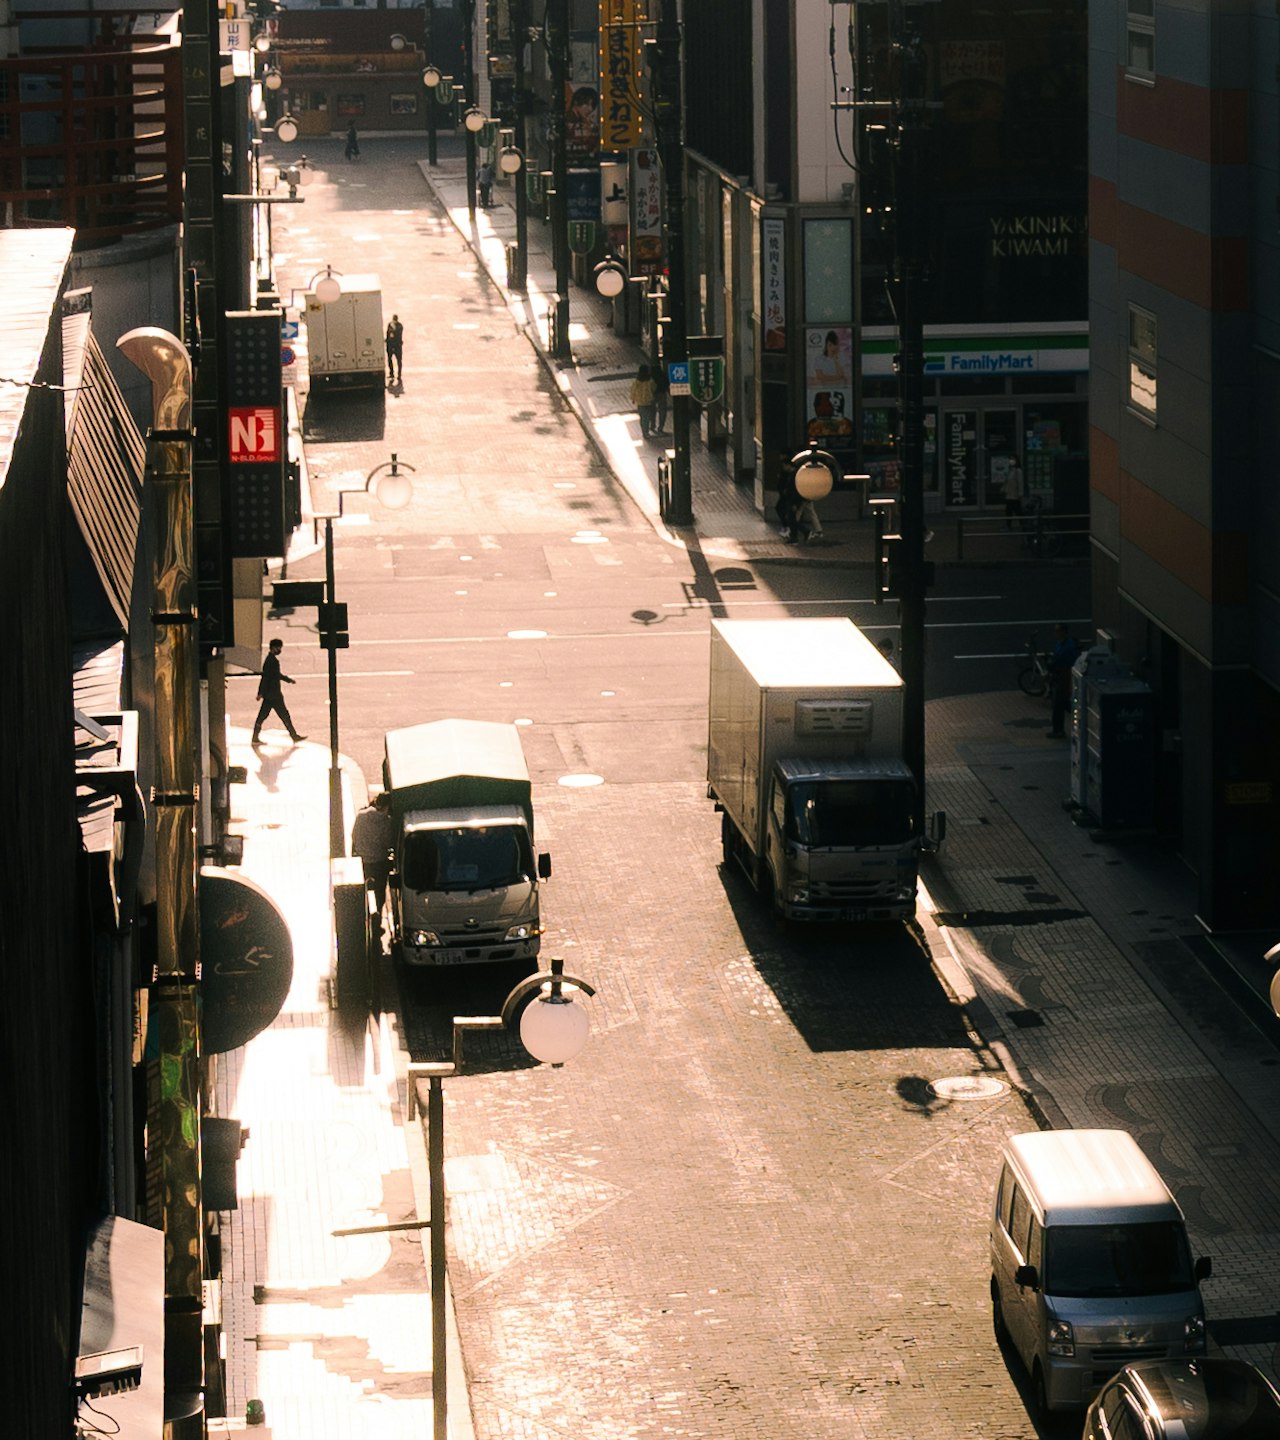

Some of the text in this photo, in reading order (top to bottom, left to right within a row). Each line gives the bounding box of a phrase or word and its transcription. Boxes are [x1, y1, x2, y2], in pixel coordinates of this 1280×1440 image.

[992, 237, 1069, 257] KIWAMI
[951, 354, 1033, 371] FamilyMart
[947, 413, 967, 504] FamilyMart
